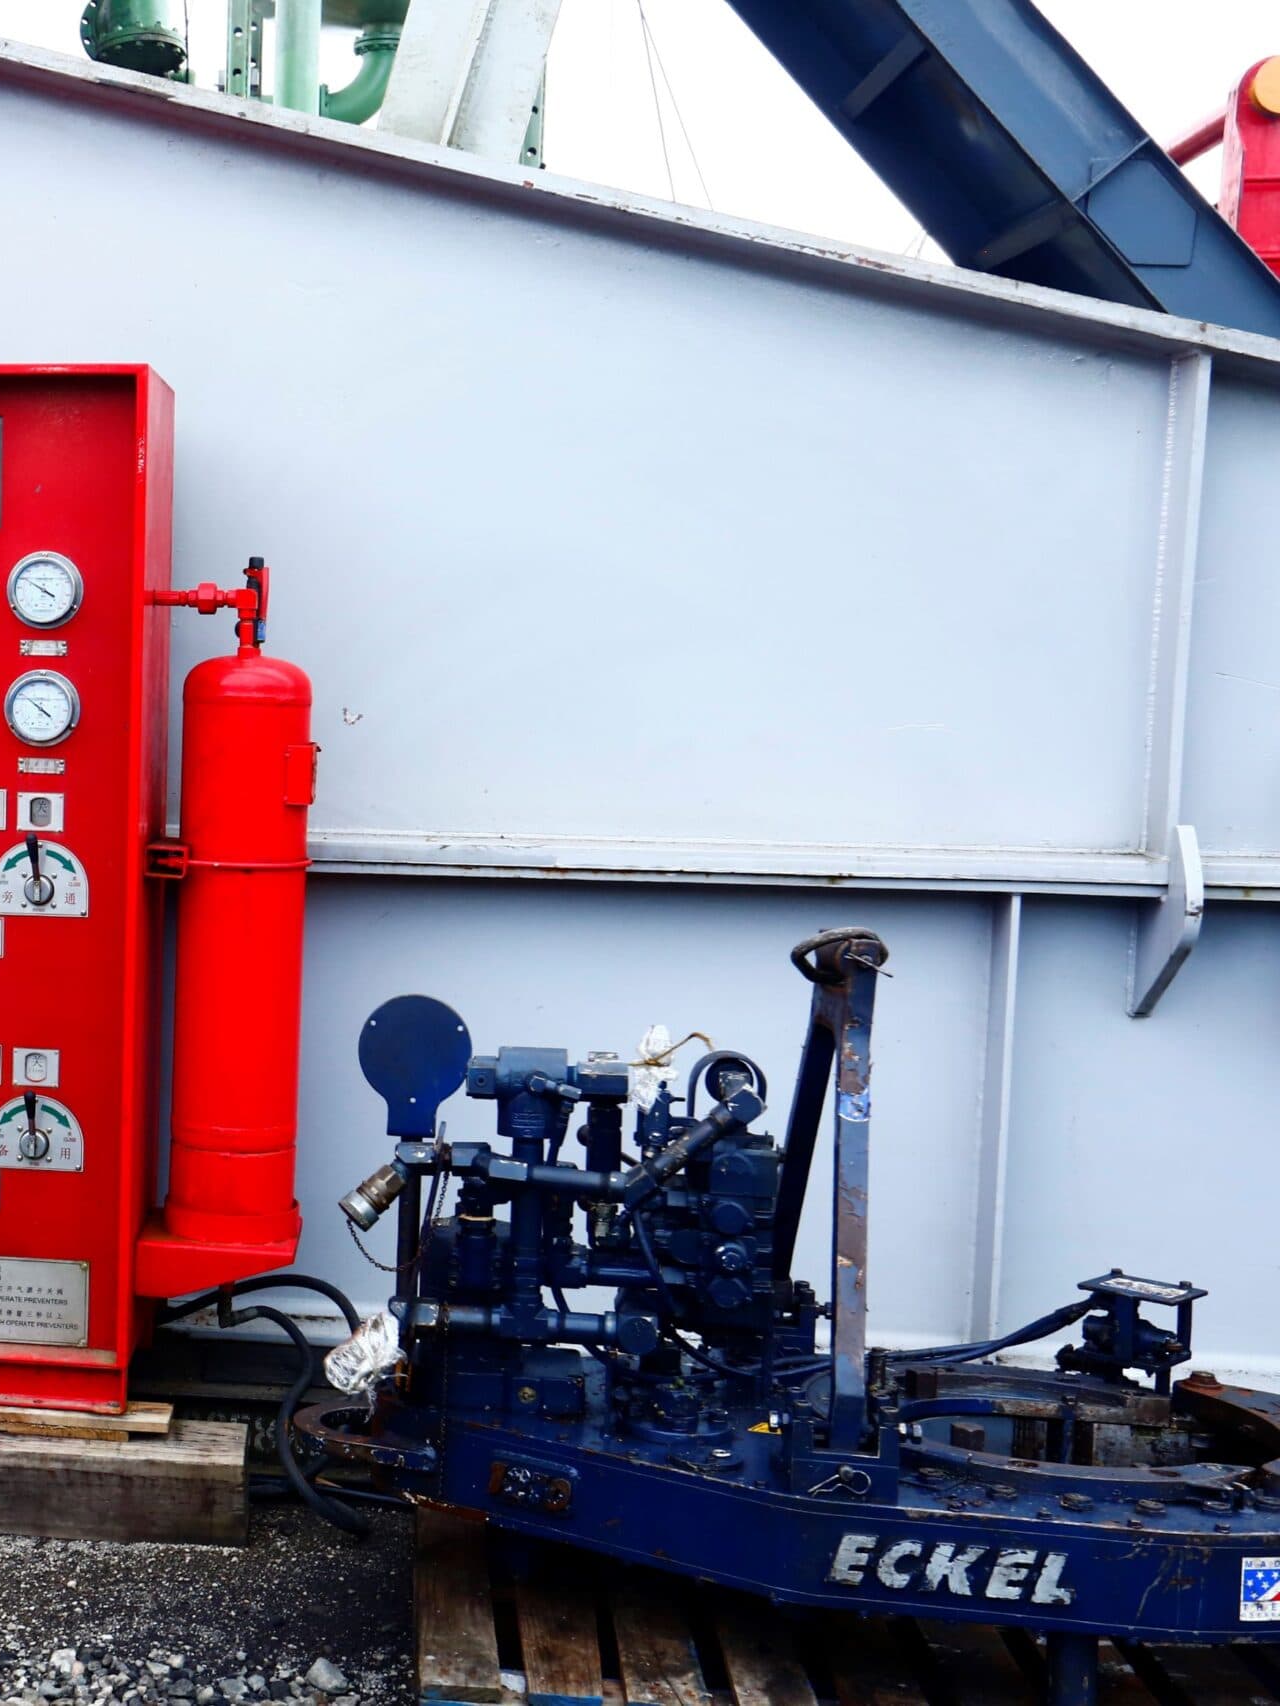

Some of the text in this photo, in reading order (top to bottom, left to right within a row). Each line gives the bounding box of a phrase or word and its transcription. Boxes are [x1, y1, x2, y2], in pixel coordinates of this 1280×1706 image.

[24, 1296, 68, 1306] PREVENTERS
[5, 1319, 35, 1328] OPERATE
[827, 1534, 1077, 1605] ECKEL
